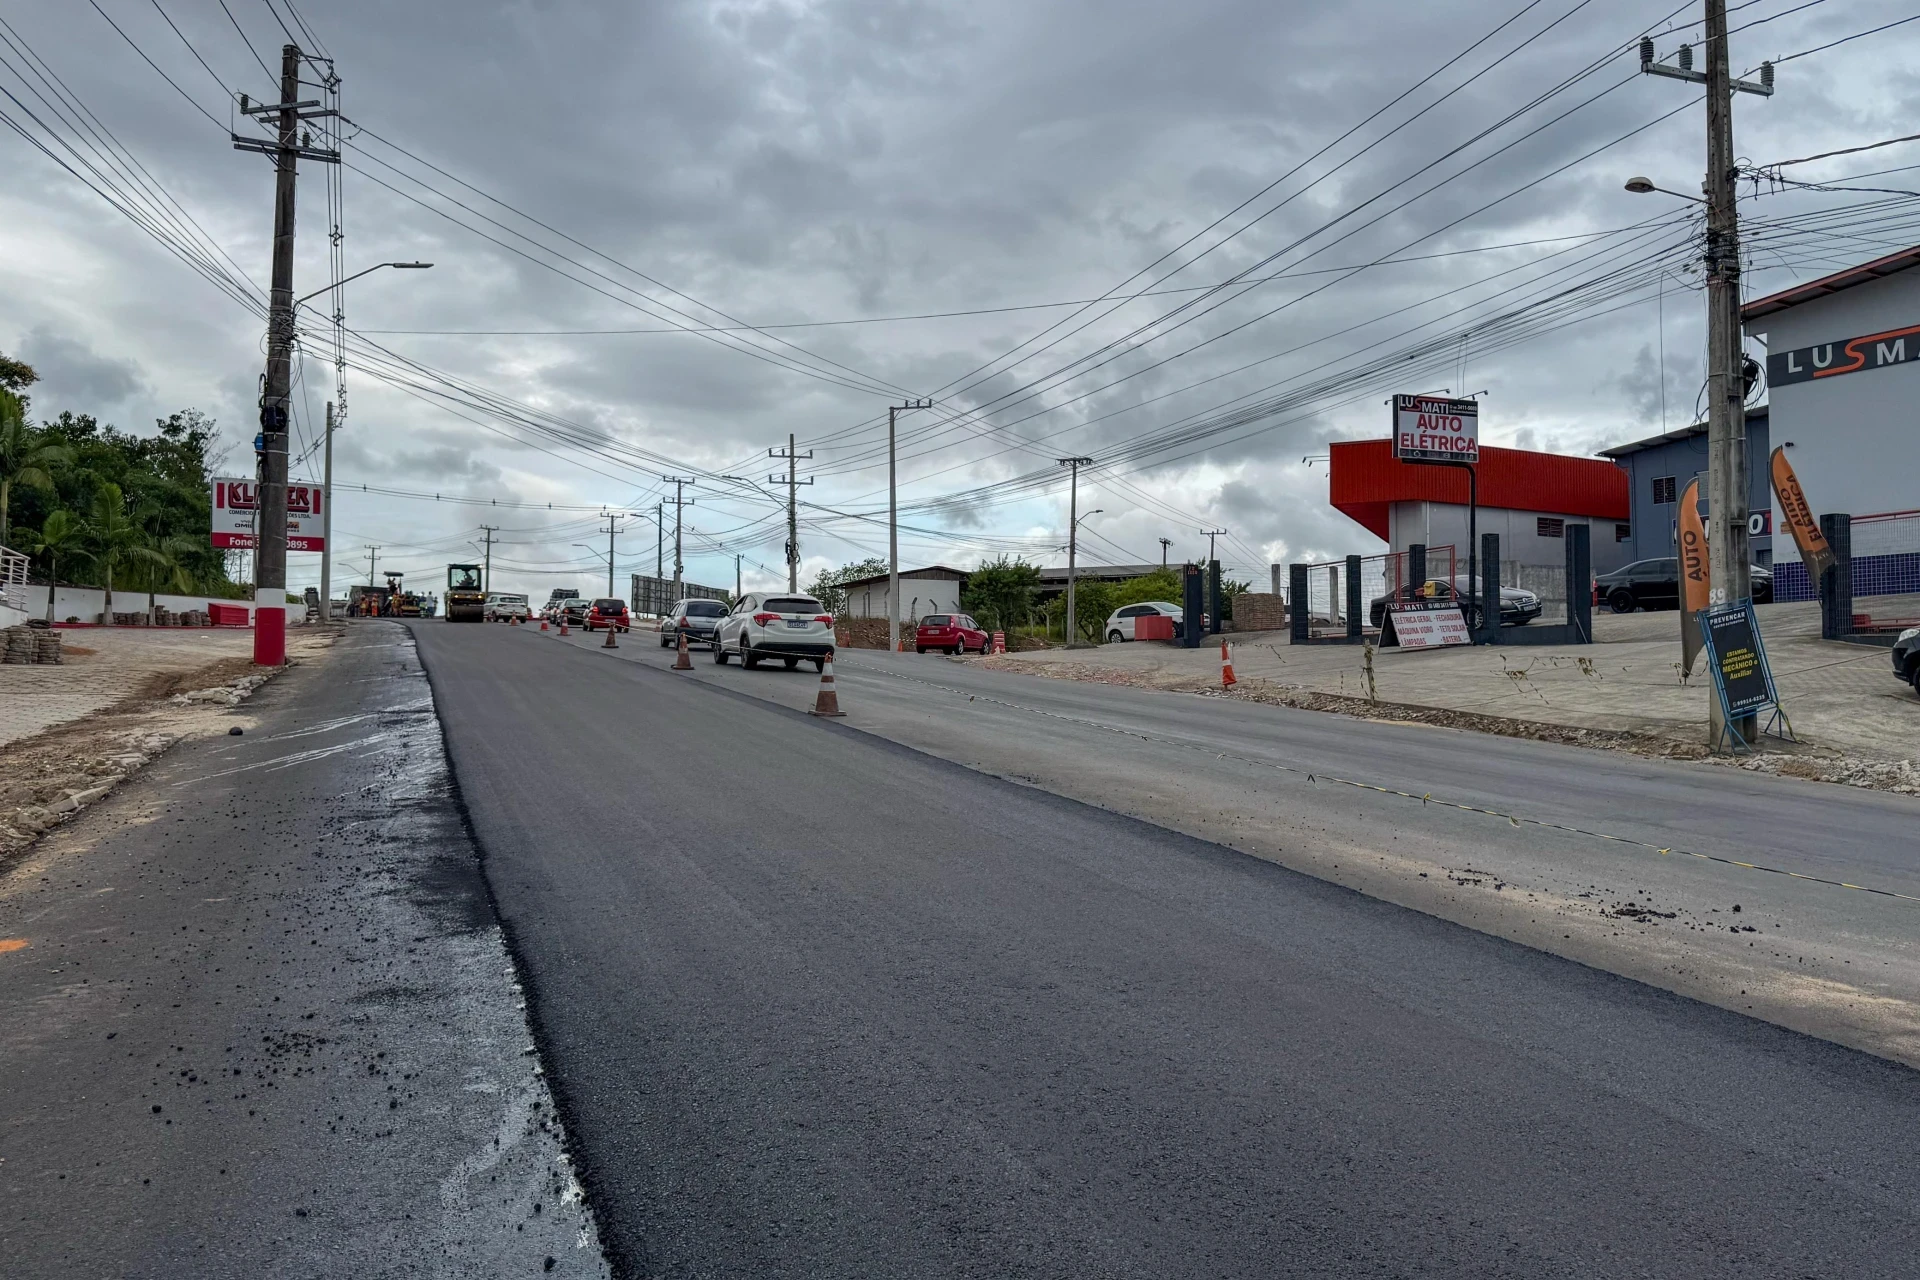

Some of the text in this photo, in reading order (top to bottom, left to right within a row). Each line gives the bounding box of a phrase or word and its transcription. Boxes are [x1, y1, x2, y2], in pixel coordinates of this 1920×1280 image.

[1416, 414, 1462, 432] AUTO
[1400, 430, 1477, 453] ELÉTRICA
[1683, 530, 1703, 582] AUTO
[1394, 616, 1417, 624] ELÉTRICA
[1709, 612, 1746, 625] PREVENCAR
[1722, 653, 1755, 664] CONTRATANDO
[1726, 648, 1748, 657] ESTAMOS
[1722, 660, 1753, 673] MECÂNICO
[1729, 670, 1753, 680] Auxiliar
